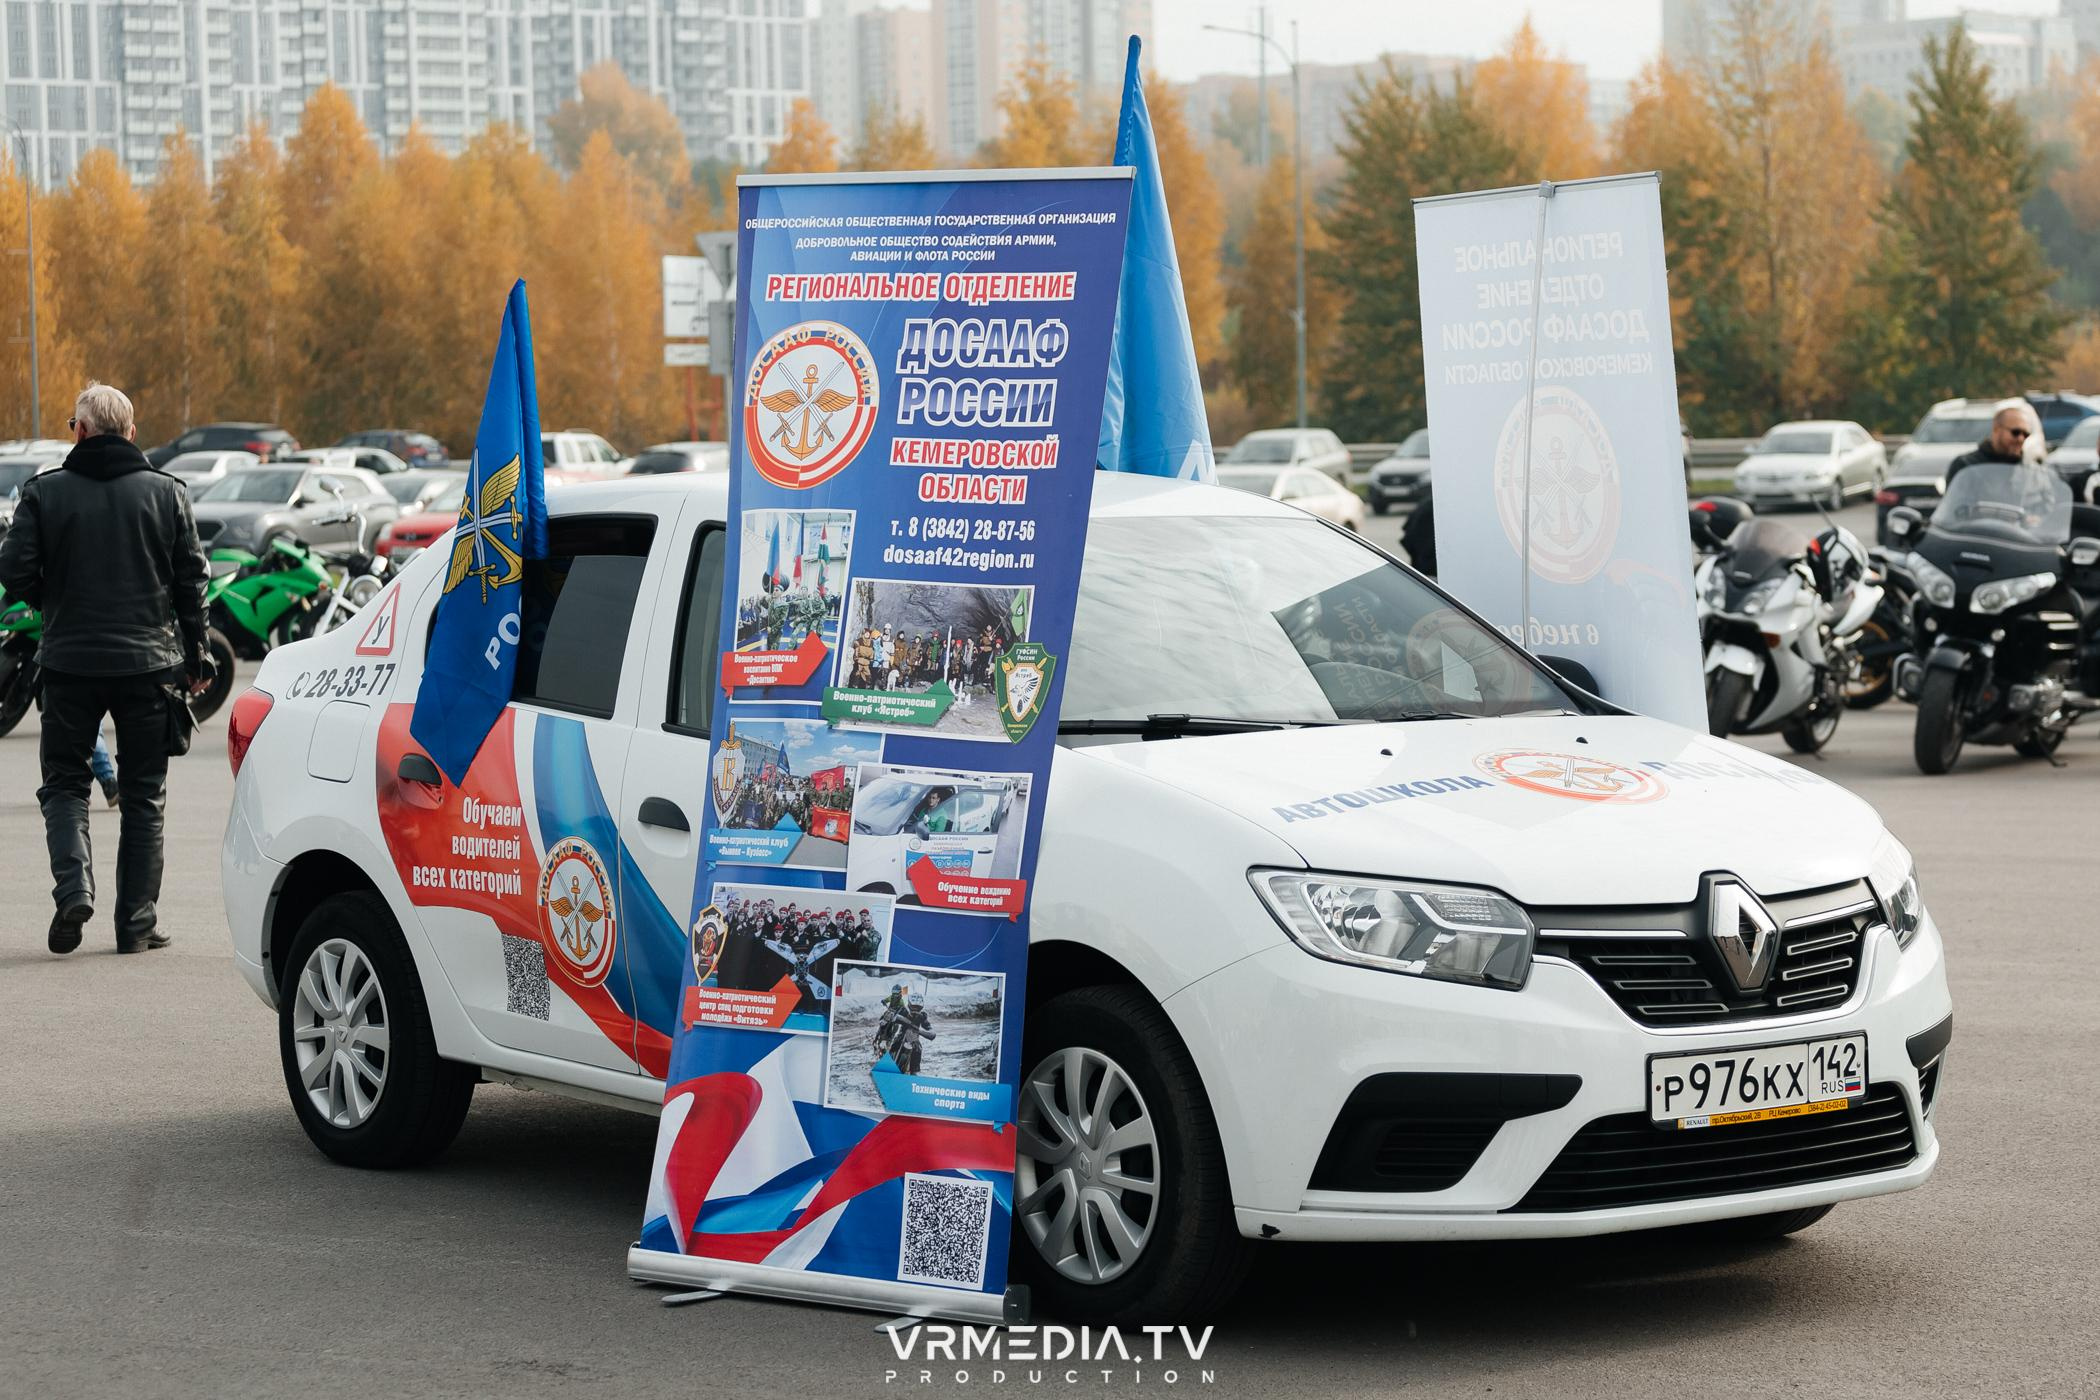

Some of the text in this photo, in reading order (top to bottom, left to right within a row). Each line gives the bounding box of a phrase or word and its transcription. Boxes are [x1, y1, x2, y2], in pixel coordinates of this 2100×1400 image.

[745, 212, 1116, 230] ОБЩЕРОССИЙСКАЯ ОБЩЕСТВЕННАЯ ГОСУДАРСТВЕННАЯ ОРГАНИЗАЦИЯ
[796, 234, 1057, 250] ДОБРОВОЛЬНОЕ ОБЩЕСТВО СОДЕЙСТВИЯ АРМИИ,
[850, 250, 996, 262] АВИАЦИИ И ФЛОТА РОССИИ
[766, 272, 1075, 305] РЕГИОНАЛЬНОЕ ОТДЕЛЕНИЕ
[896, 318, 1068, 374] ДОСААФ
[747, 326, 876, 400] ДОСААФ РОССИИ
[897, 378, 1057, 426] РОССИИ
[890, 435, 1059, 469] КЕМЕРОВСКОЙ
[919, 473, 1028, 504] ОБЛАСТИ
[891, 517, 1036, 543] т. 8 (3842) 28-87-56
[884, 544, 1035, 572] dosaaf42region.ru
[484, 595, 522, 671] РО
[304, 662, 396, 698] 28-33-77
[833, 690, 936, 708] Военно-патриотический
[851, 704, 915, 718] клуб «Ястреб»
[1271, 774, 1496, 823] АВТОШКОЛА
[463, 796, 522, 831] Обучаем
[452, 836, 520, 860] водителей
[770, 838, 788, 848] клуб
[412, 866, 522, 900] всех категорий
[540, 841, 614, 914] ДОСААФ РОССИИ
[938, 882, 978, 896] Обучение
[948, 895, 1004, 907] всех категорий
[699, 1001, 716, 1010] центр
[732, 1004, 774, 1015] подготовки
[733, 1014, 768, 1026] «Витязь»
[1664, 1042, 1857, 1112] Р976КХ 142
[1822, 1080, 1844, 1094] RUS
[912, 1083, 990, 1100] Технические виды
[934, 1099, 966, 1110] спорта
[1686, 1118, 1709, 1127] RENAULT
